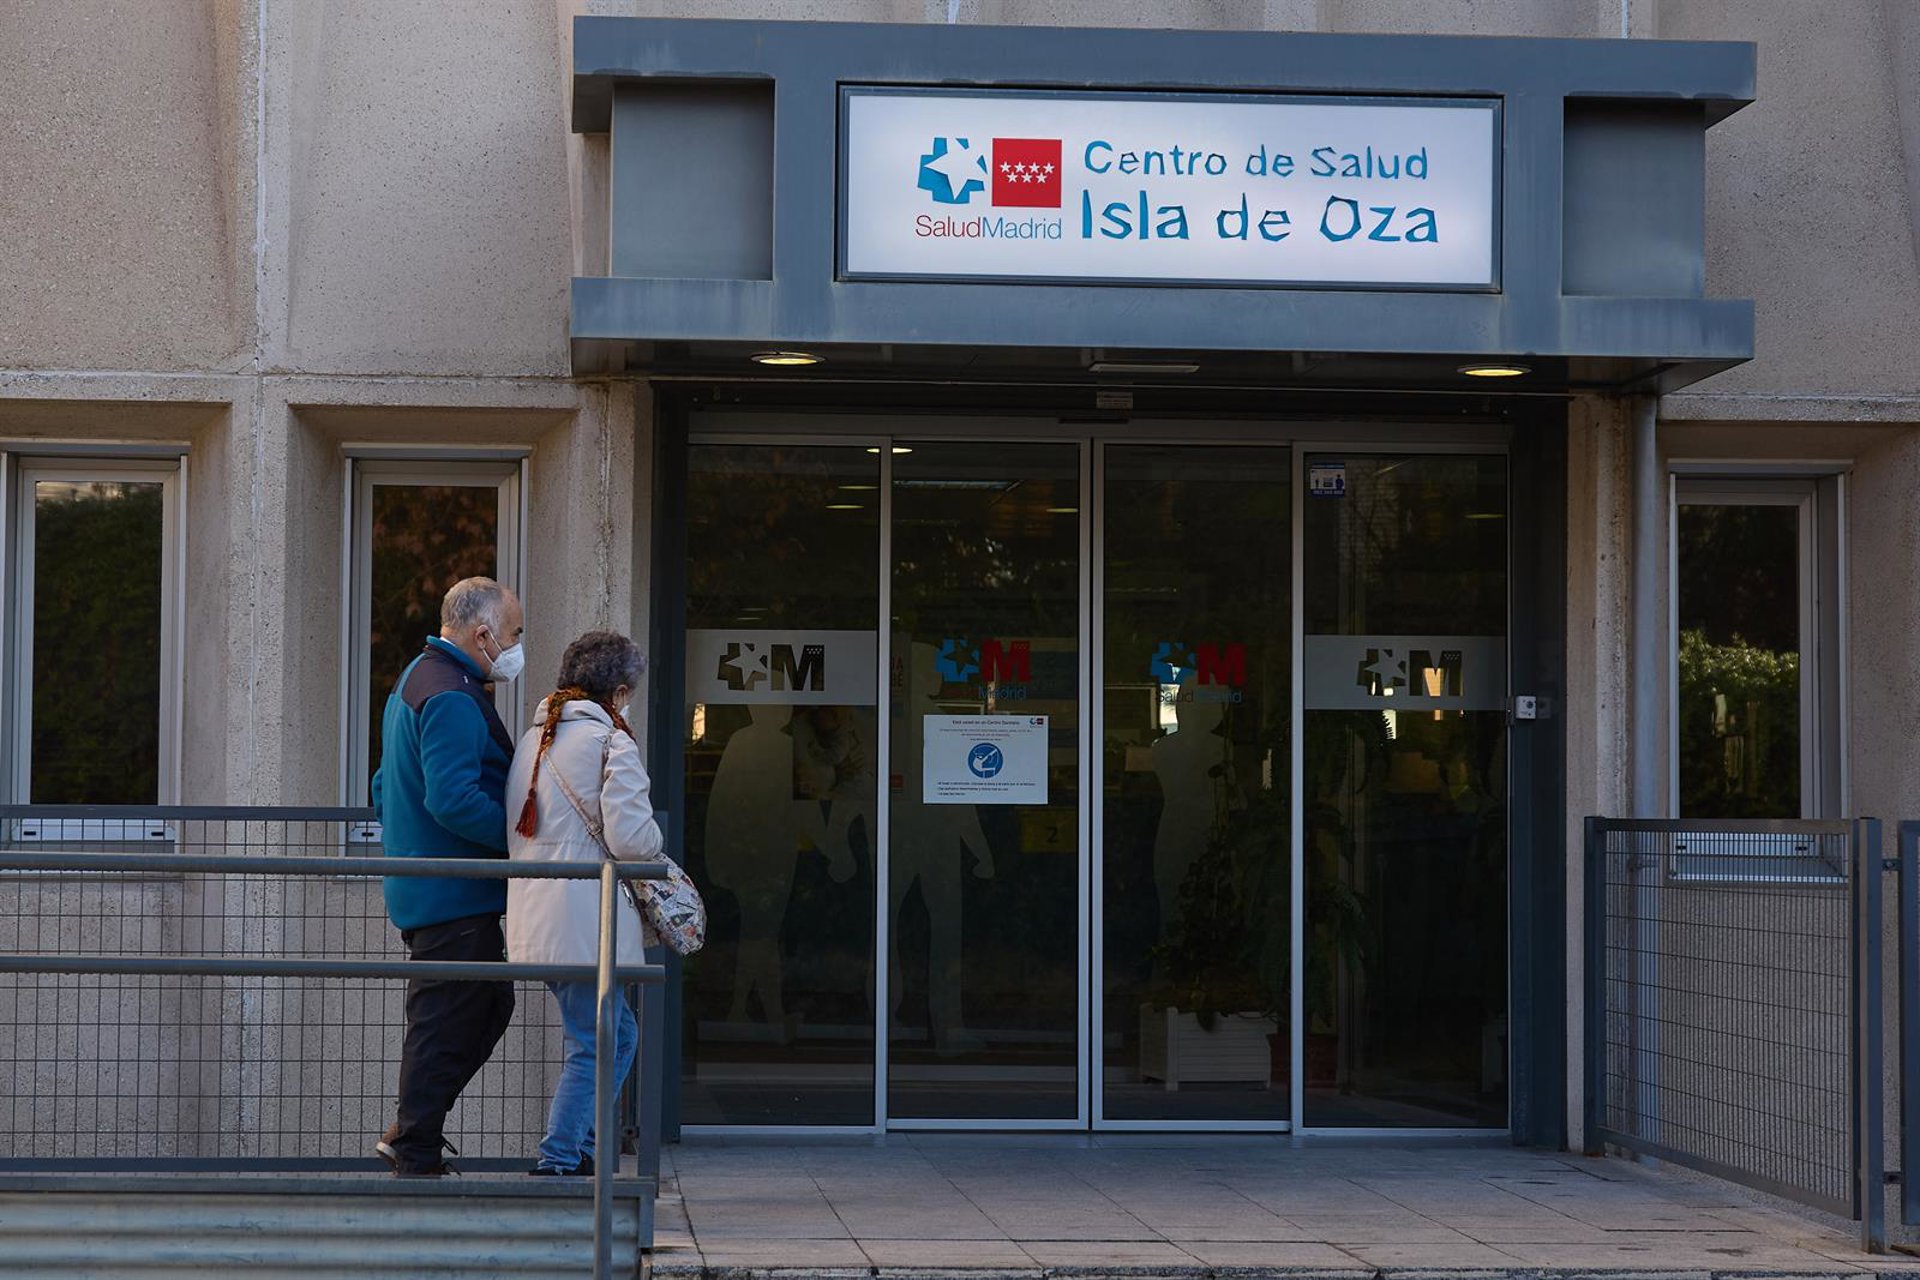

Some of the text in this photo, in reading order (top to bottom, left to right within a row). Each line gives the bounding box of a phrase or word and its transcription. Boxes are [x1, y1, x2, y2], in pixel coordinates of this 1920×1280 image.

[1084, 140, 1428, 180] Centro de Salud
[1081, 189, 1440, 243] Isla de Oza
